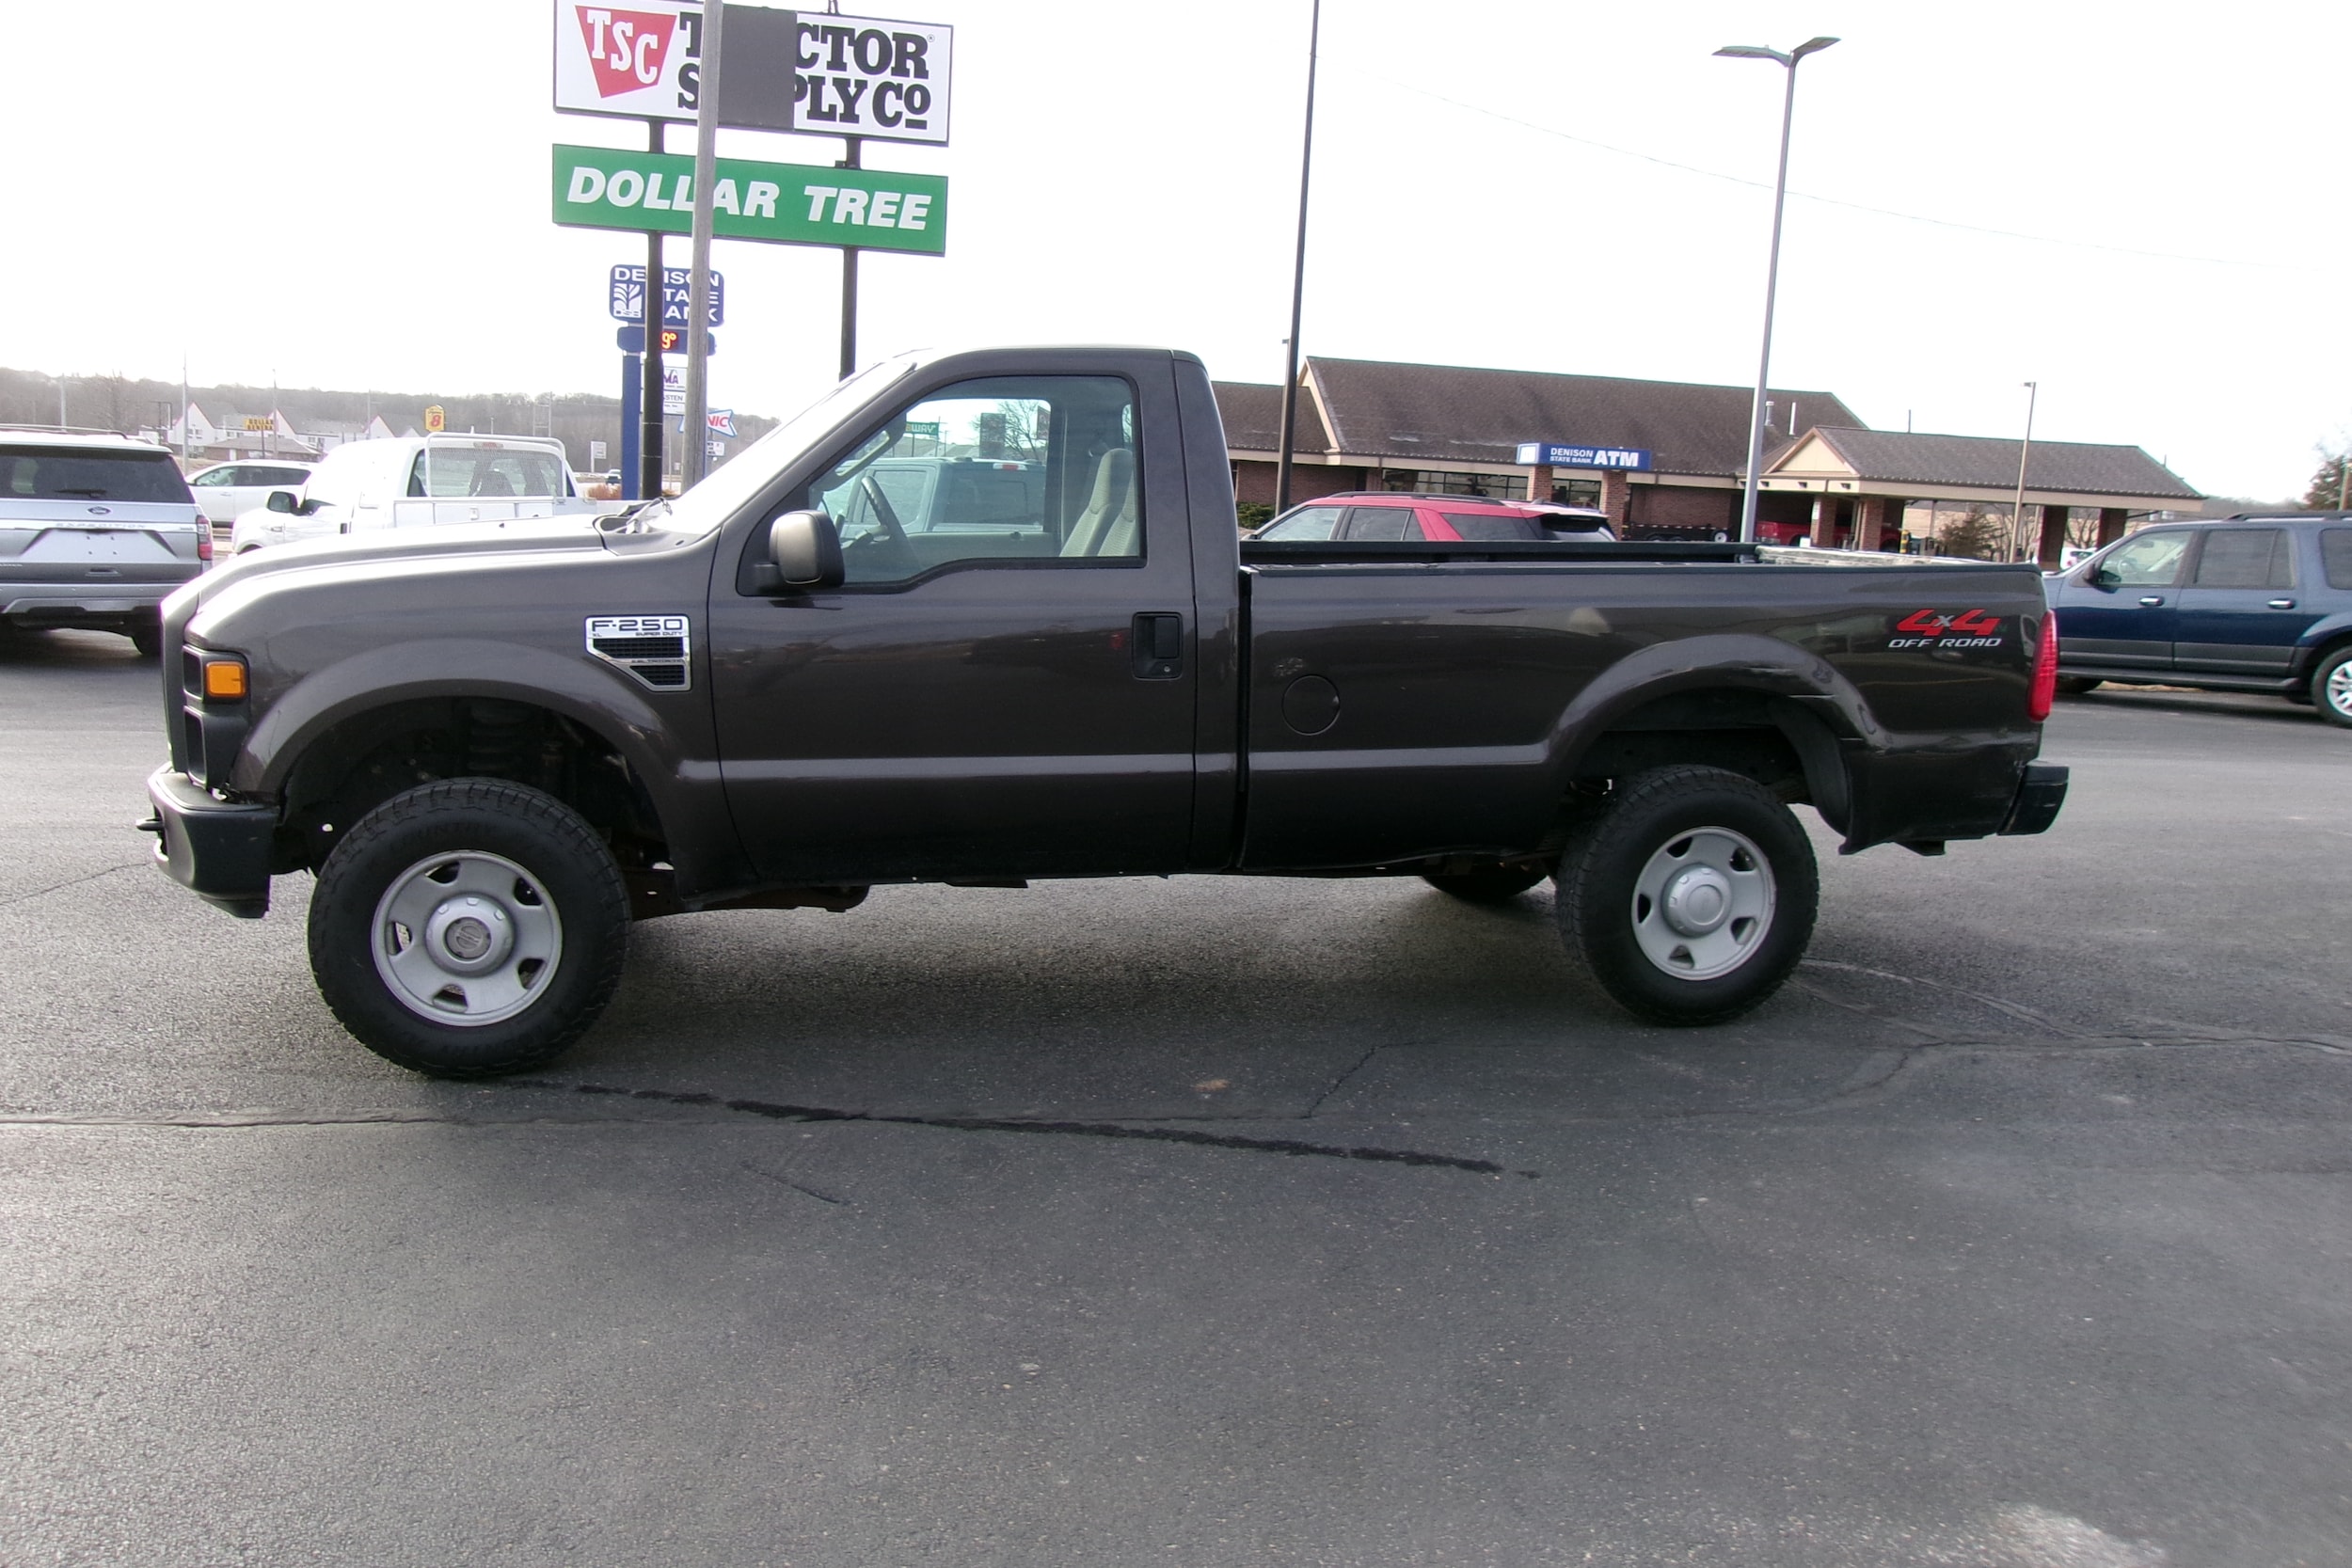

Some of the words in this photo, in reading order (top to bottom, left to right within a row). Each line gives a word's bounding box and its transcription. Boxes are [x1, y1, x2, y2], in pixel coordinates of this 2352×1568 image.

[586, 8, 659, 85] TSC
[679, 10, 930, 80] TCTOR
[566, 166, 781, 218] DOLLAR
[803, 185, 932, 230] TREE
[614, 267, 720, 287] DEISN
[663, 288, 719, 305] TAE
[430, 414, 442, 427] 8
[1550, 448, 1594, 457] DENISON
[1593, 450, 1639, 467] ATM
[592, 619, 682, 631] F-250
[1887, 638, 1935, 648] OFF
[1938, 637, 2003, 647] ROAD
